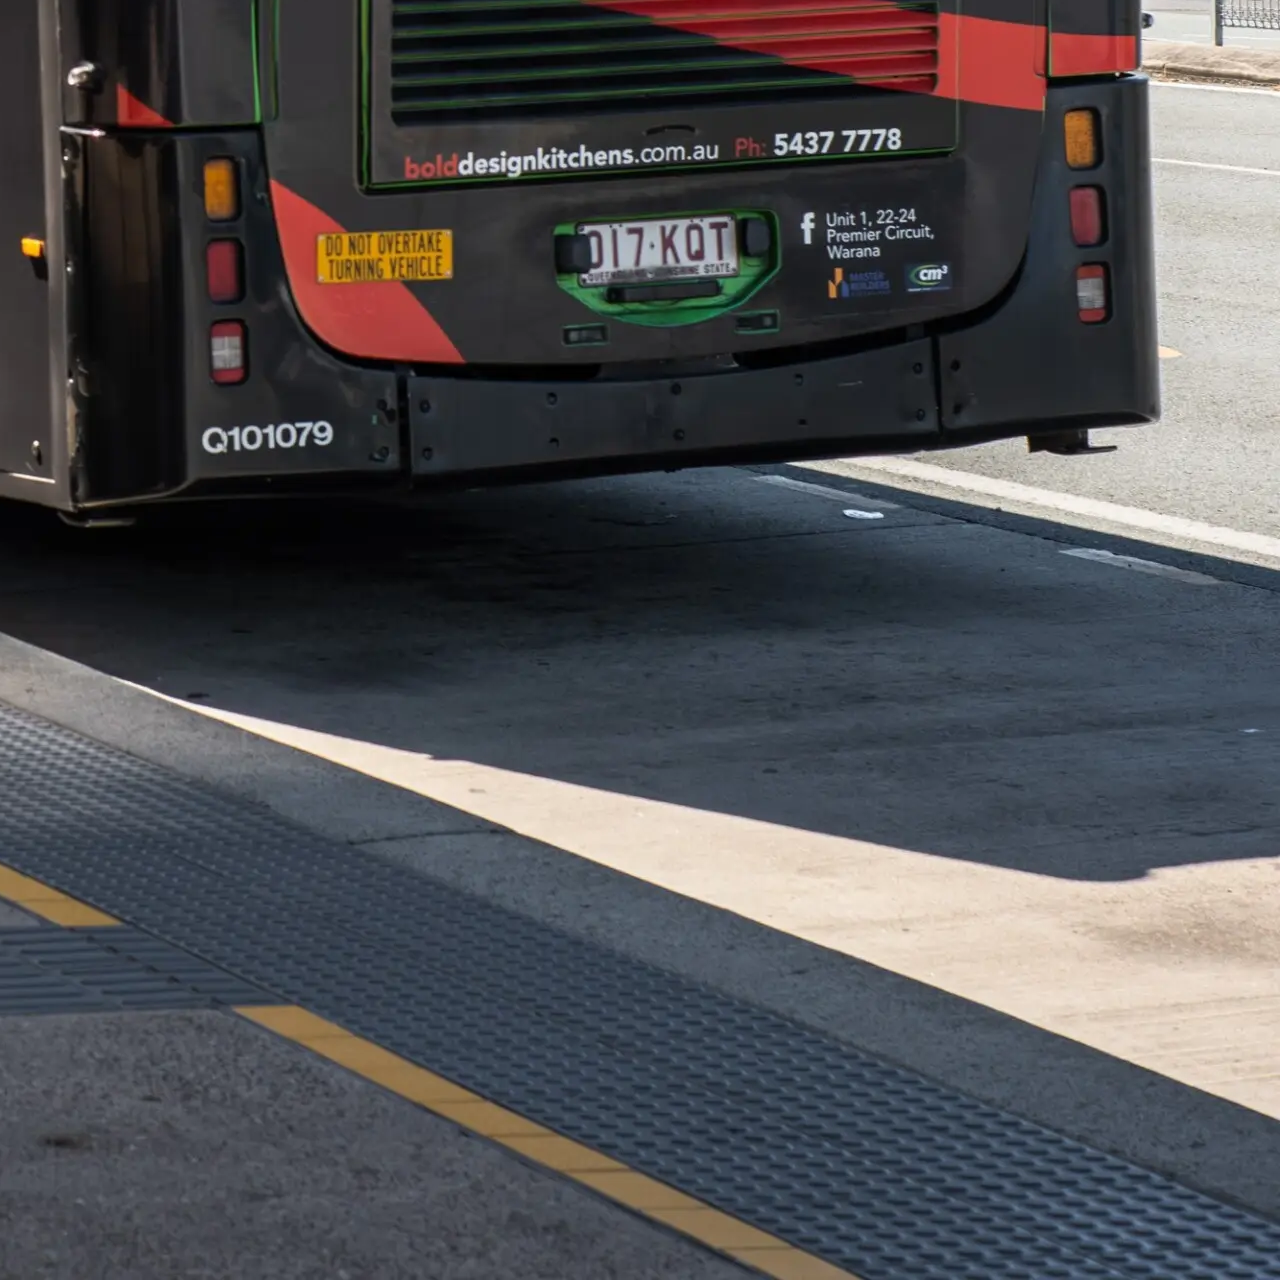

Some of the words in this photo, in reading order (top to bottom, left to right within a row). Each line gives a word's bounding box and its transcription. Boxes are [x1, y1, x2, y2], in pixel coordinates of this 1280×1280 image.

[403, 141, 719, 180] bolddesignkitchens.com.au
[734, 136, 767, 158] Ph:
[773, 130, 835, 156] 5437
[841, 127, 902, 153] 7778
[826, 212, 856, 227] Unit
[860, 211, 873, 227] 1,
[876, 208, 917, 225] 22-24
[325, 235, 342, 256] DO
[348, 233, 373, 255] NOT
[378, 231, 444, 254] OVERTAKE
[826, 228, 881, 243] Premier
[884, 224, 935, 240] Circuit,
[826, 245, 881, 259] Warana
[328, 258, 385, 281] TURNING
[389, 256, 444, 278] VEHICLE
[703, 262, 731, 275] STATE
[201, 420, 334, 454] Q101079
